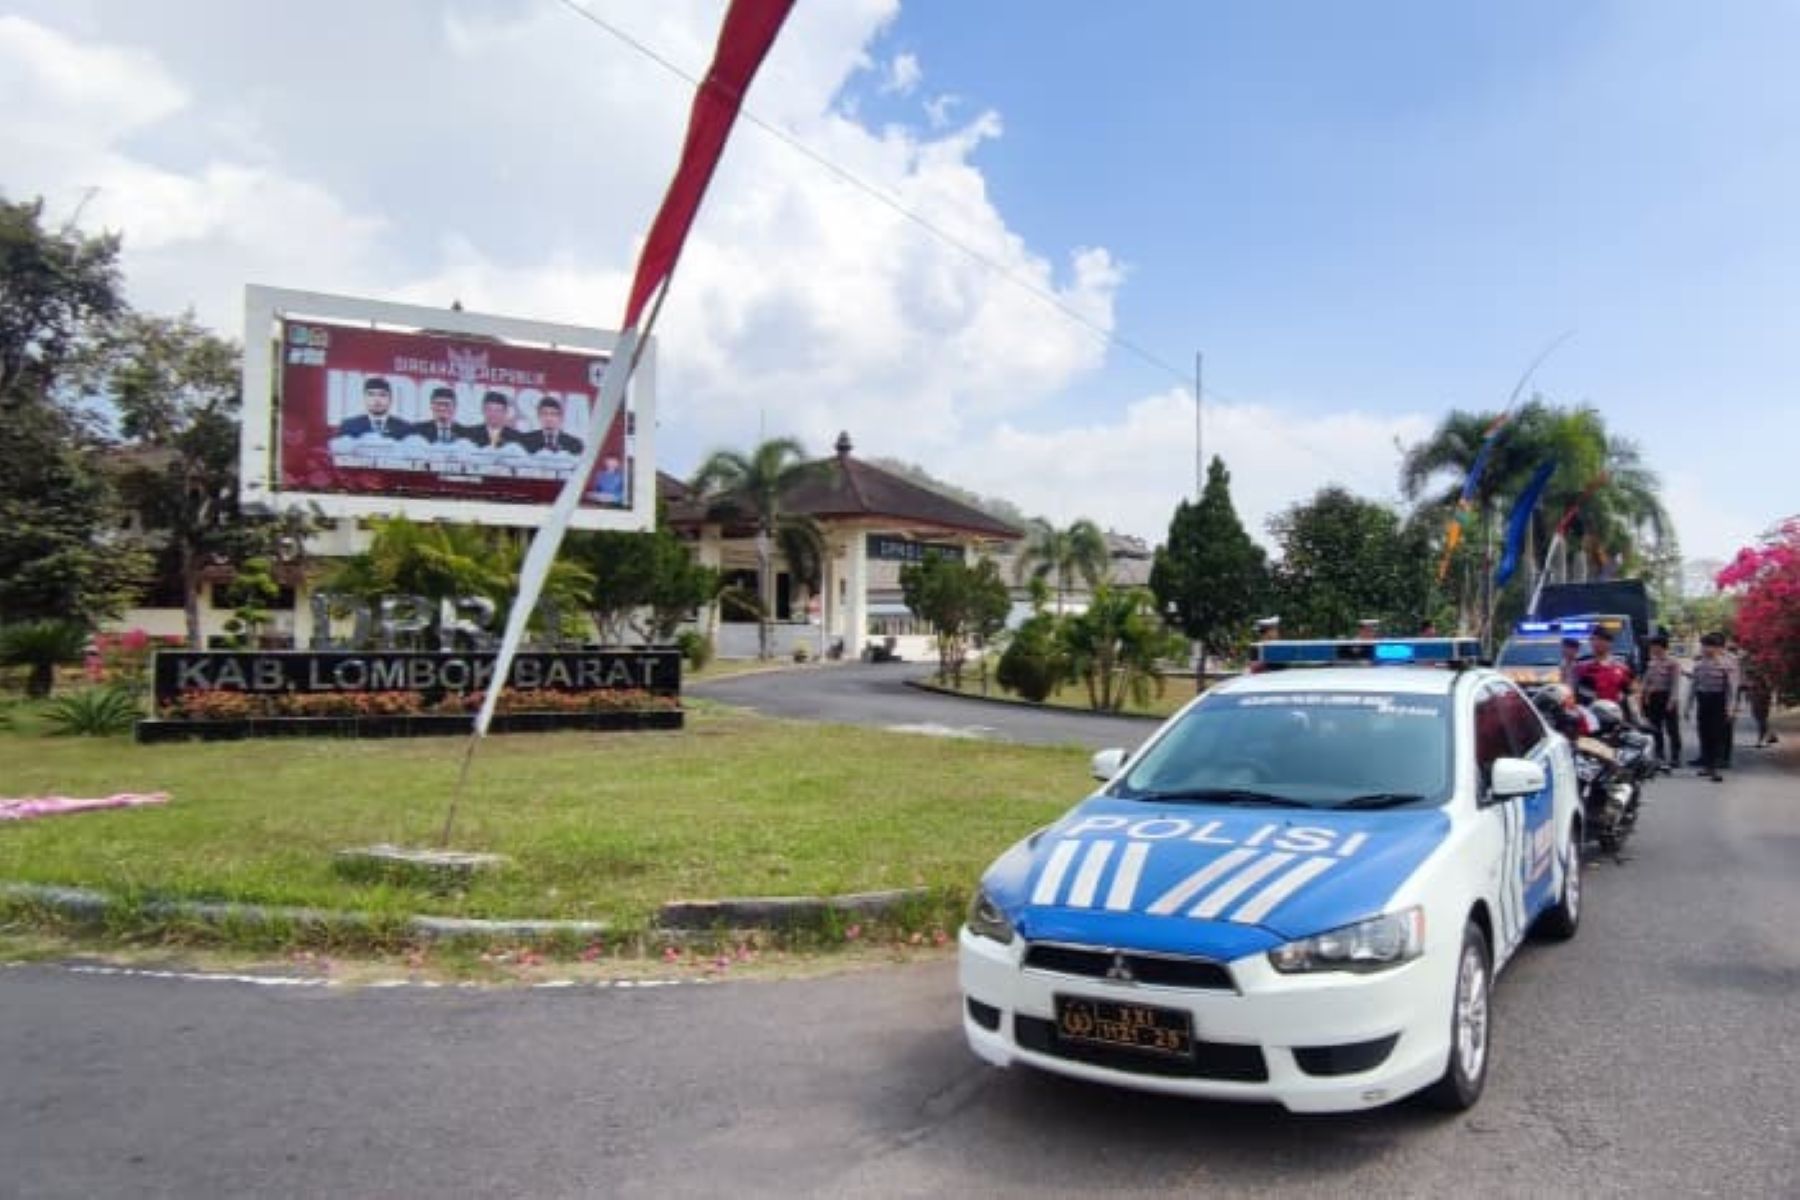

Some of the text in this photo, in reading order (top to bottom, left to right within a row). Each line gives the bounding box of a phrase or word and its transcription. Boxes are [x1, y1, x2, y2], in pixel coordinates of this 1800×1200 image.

[177, 656, 661, 691] KAB. LOMBOK BARAT
[1064, 813, 1370, 858] POLISI
